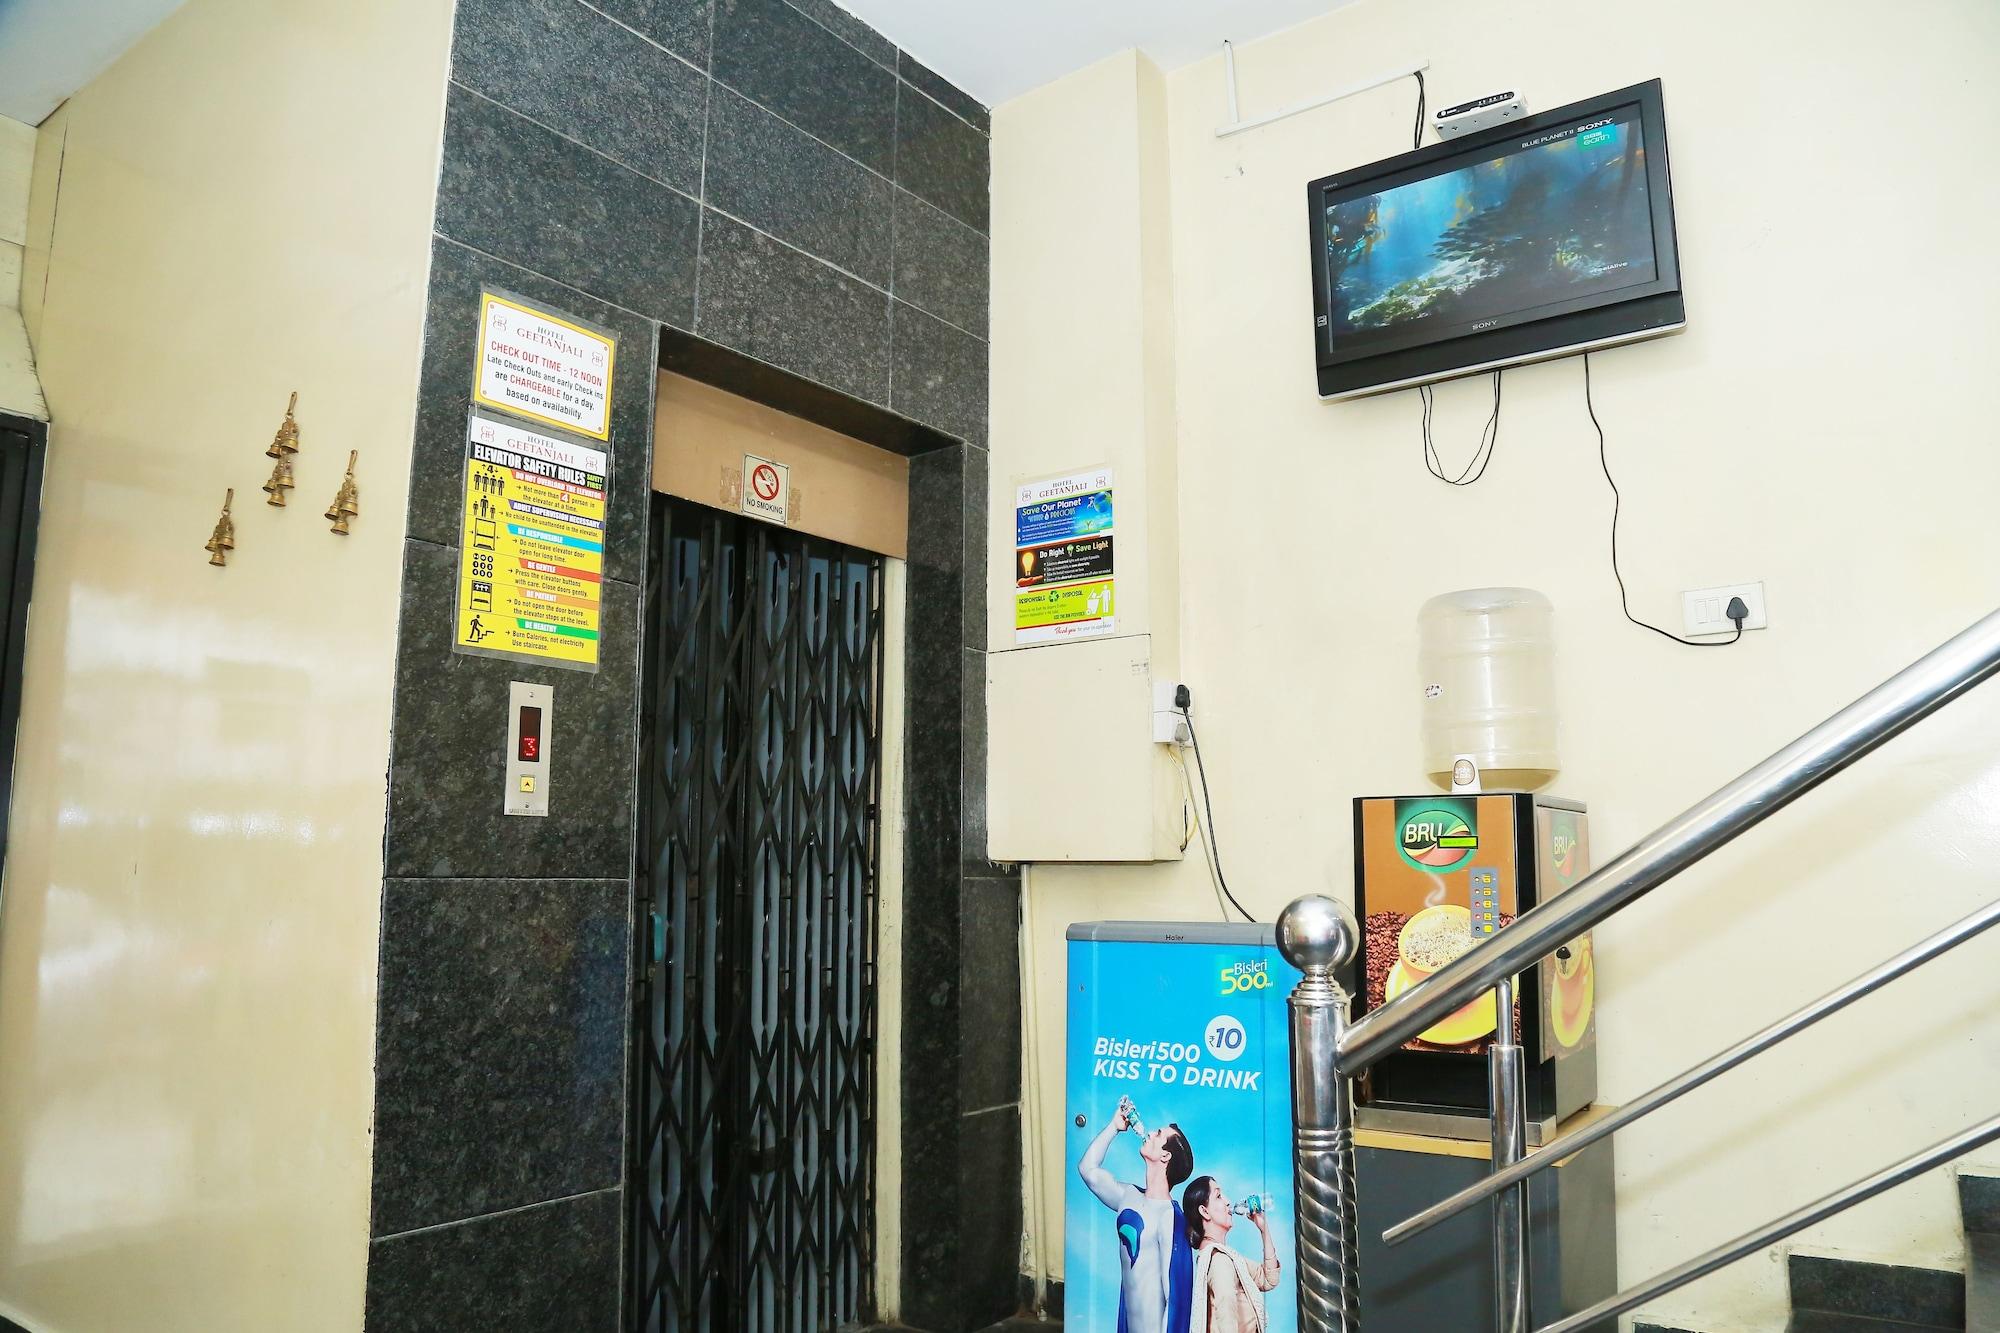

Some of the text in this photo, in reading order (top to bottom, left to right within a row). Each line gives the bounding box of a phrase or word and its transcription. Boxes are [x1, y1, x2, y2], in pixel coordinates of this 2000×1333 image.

[1577, 118, 1613, 132] SONY
[1522, 139, 1539, 148] BLUE
[1541, 131, 1568, 143] PLANET
[1584, 134, 1610, 146] earth
[1472, 320, 1497, 330] SONY
[537, 326, 565, 342] HOTEL
[517, 328, 583, 358] GEETANJALI
[491, 340, 520, 358] CHECK
[522, 352, 539, 364] OUT
[542, 358, 561, 372] TIME
[570, 368, 578, 378] 12
[580, 372, 602, 387] NOON
[488, 354, 603, 400] Late Check Outs and early Check ins
[495, 371, 594, 411] are CHARGEABLE for a day.
[507, 387, 582, 420] based on availability.
[528, 436, 555, 449] HOTEL
[507, 439, 575, 464] GEETANJALI
[475, 444, 586, 486] ELEVATOR SAFETY RULES
[487, 465, 494, 473] 4
[587, 474, 603, 483] SAFETY
[587, 481, 602, 490] FIRST
[1052, 480, 1073, 488] HOTEL
[1039, 483, 1088, 498] GEETANJALI
[533, 497, 553, 507] elevator
[566, 504, 577, 512] time.
[548, 491, 559, 499] than
[562, 494, 568, 502] 4
[572, 498, 588, 507] person
[746, 497, 783, 514] NO SMOKING
[1022, 498, 1082, 516] Save Our Planet
[513, 502, 600, 528] ADULT SUPERVISION NECESSARY
[539, 520, 564, 530] unattended
[520, 548, 532, 556] open
[538, 543, 551, 551] leave
[552, 545, 573, 556] elevator
[1040, 540, 1108, 558] Do Right Save Light
[515, 569, 530, 577] Press
[541, 574, 561, 583] elevator
[562, 578, 581, 587] buttons
[542, 583, 556, 591] Close
[524, 610, 544, 618] elevator
[555, 606, 567, 614] door
[568, 608, 583, 616] before
[523, 642, 548, 650] staircase.
[559, 638, 584, 648] electricity
[524, 737, 535, 756] 3
[1404, 822, 1443, 844] BRU
[1554, 834, 1568, 854] BRU
[1234, 959, 1267, 976] Bisleri
[1093, 1037, 1201, 1063] Bisleri500
[1093, 1058, 1262, 1091] KISS TO DRINK
